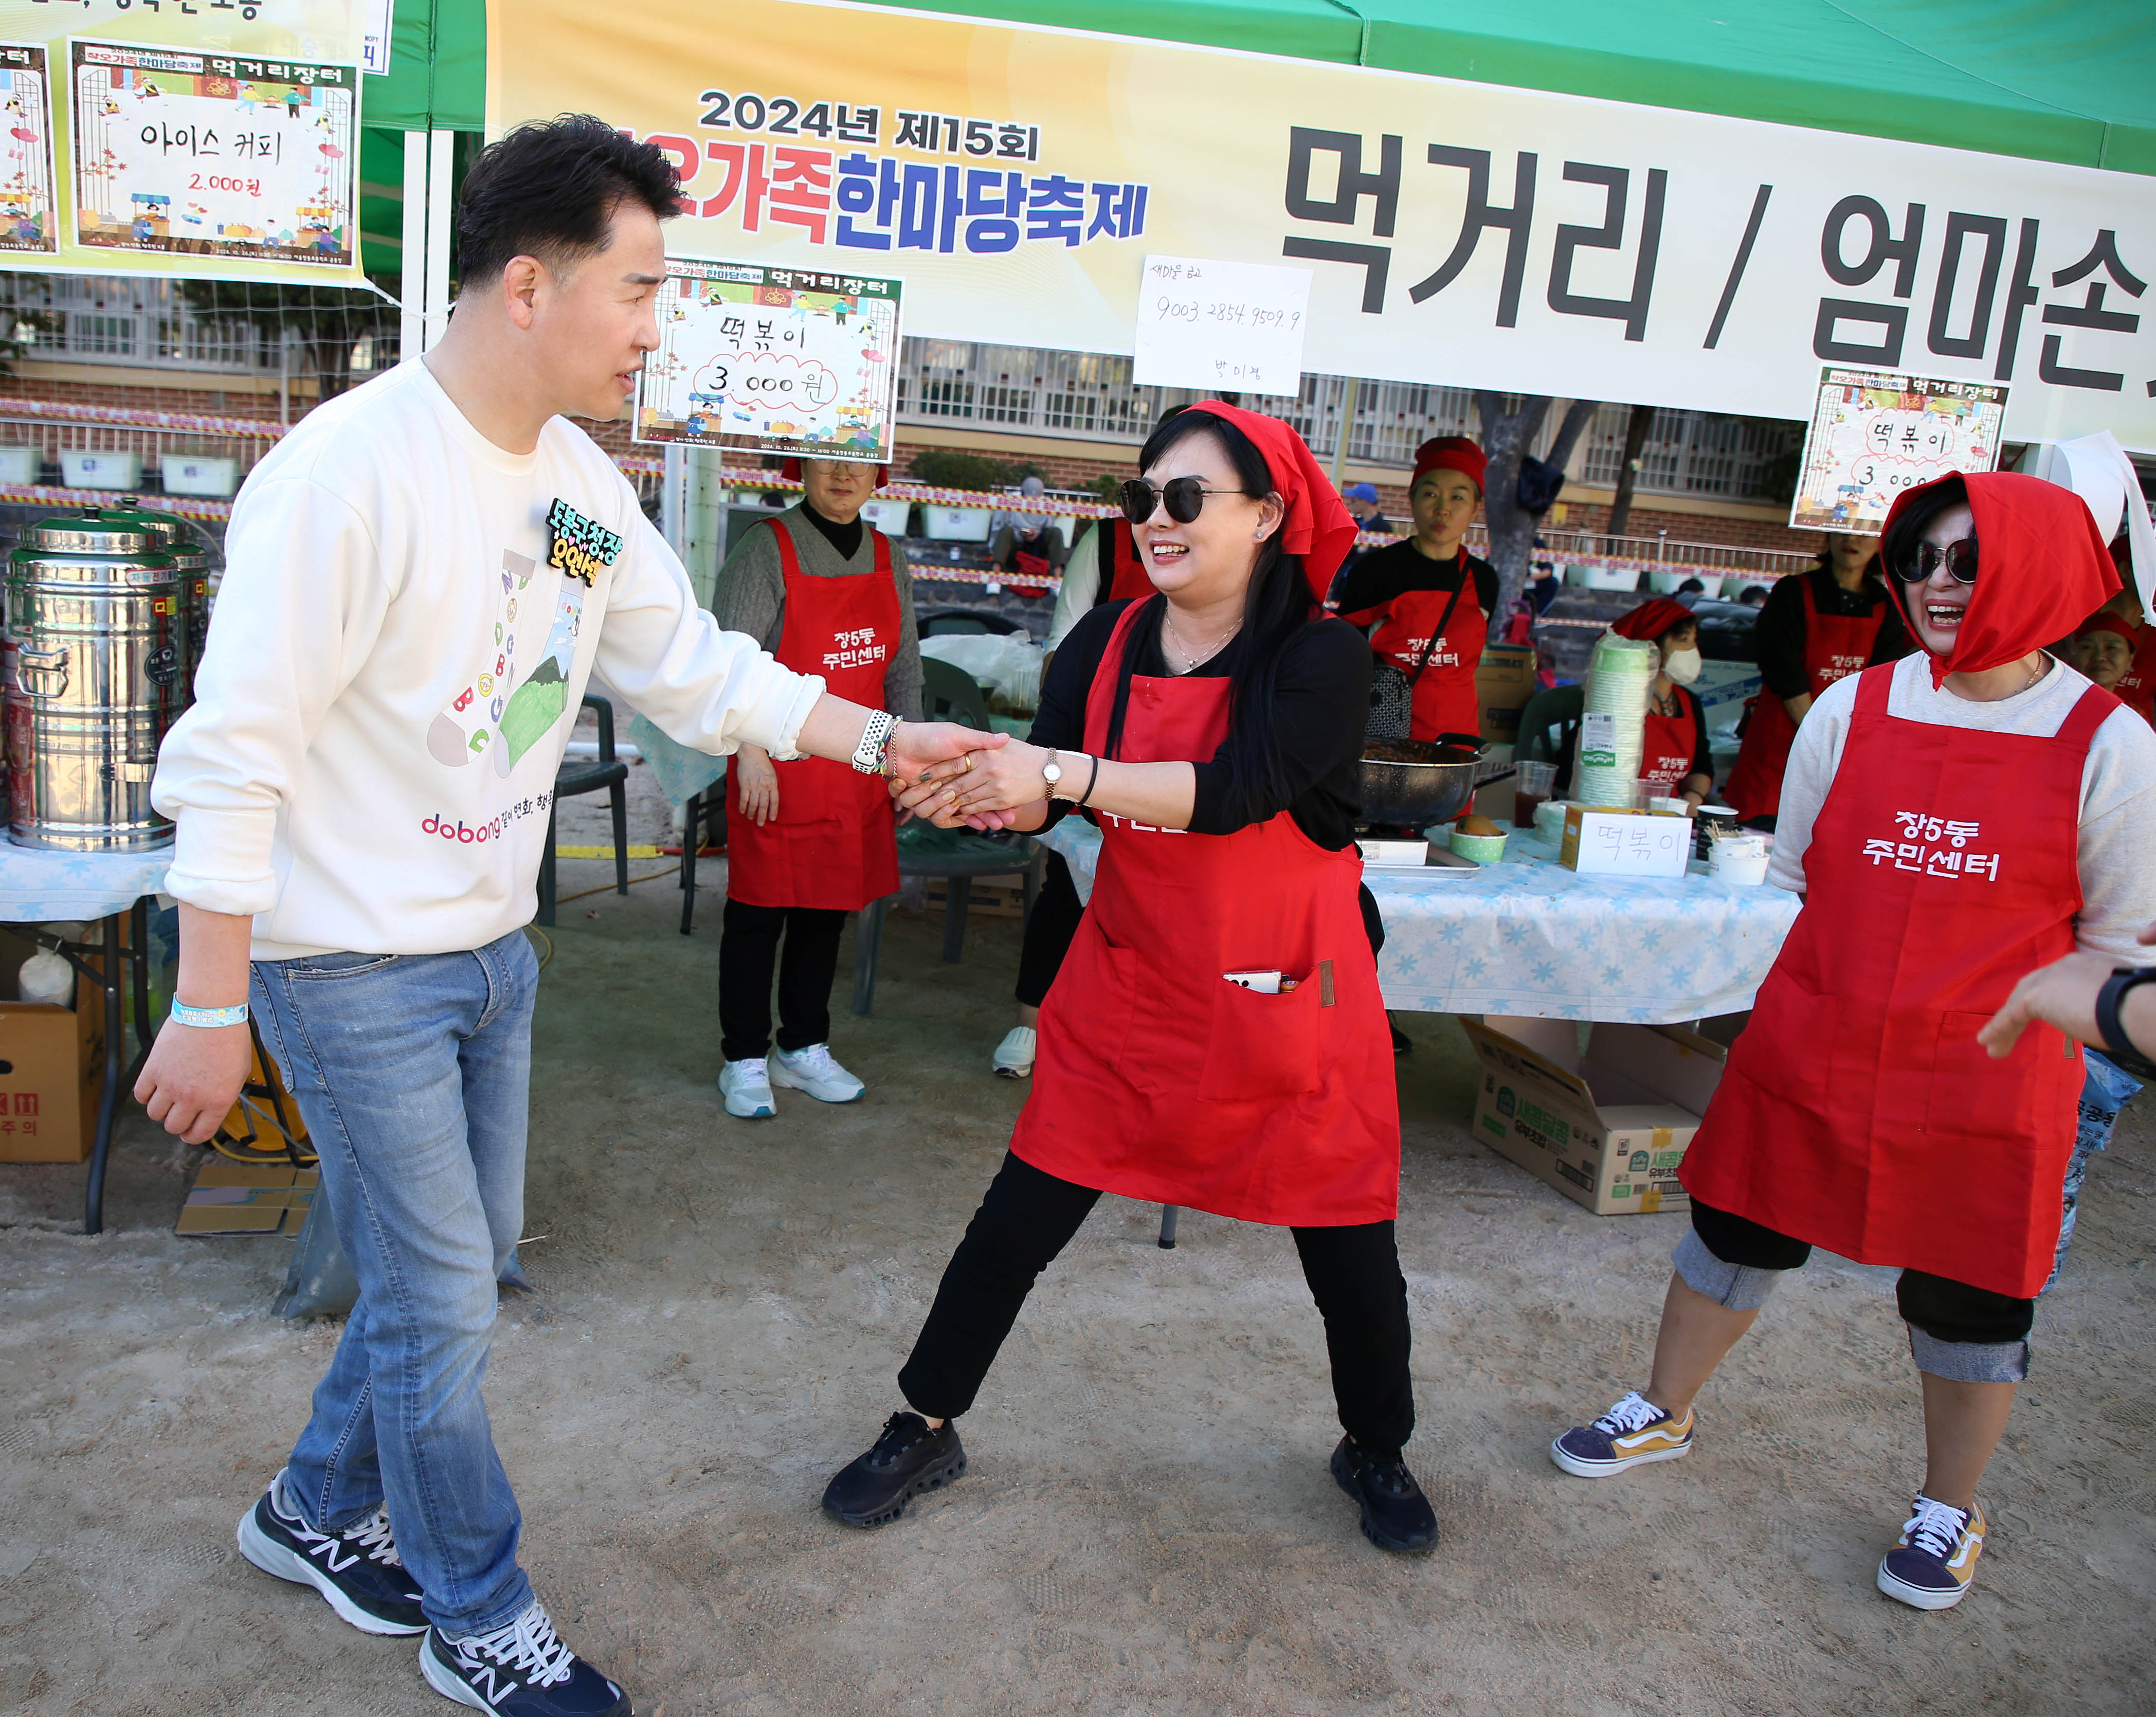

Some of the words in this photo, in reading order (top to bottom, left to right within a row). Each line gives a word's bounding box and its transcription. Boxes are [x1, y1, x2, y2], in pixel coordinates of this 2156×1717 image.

[212, 58, 342, 85] 먹거리장터
[700, 92, 878, 144] 2024년
[898, 112, 1038, 161] 제15회
[141, 120, 220, 156] 아이스
[234, 132, 282, 166] 커피
[188, 173, 263, 197] 2.000원
[619, 130, 1148, 252] 오가족한마당축제
[1282, 125, 1668, 341] 먹거리
[1702, 184, 1773, 350] /
[1812, 194, 2156, 399] 엄마손
[771, 270, 888, 296] 먹거리장터
[720, 317, 805, 351] 떡볶이
[1913, 378, 1999, 401] 먹거리장터
[1874, 423, 1946, 454] 떡볶이
[1859, 466, 1947, 485] 3.000
[550, 500, 623, 565] 도봉구청장
[834, 627, 876, 649] 창5동
[822, 643, 886, 671] 주민센터
[1831, 655, 1865, 668] 창5동
[1658, 756, 1689, 770] 창5동
[422, 813, 501, 843] dobong
[501, 809, 513, 828] 같이
[514, 798, 533, 820] 변화,
[1598, 826, 1681, 861] 떡볶이
[1894, 810, 1980, 848] 창5동
[1862, 838, 2000, 882] 주민센터
[1514, 1119, 1547, 1150] 유부초밥
